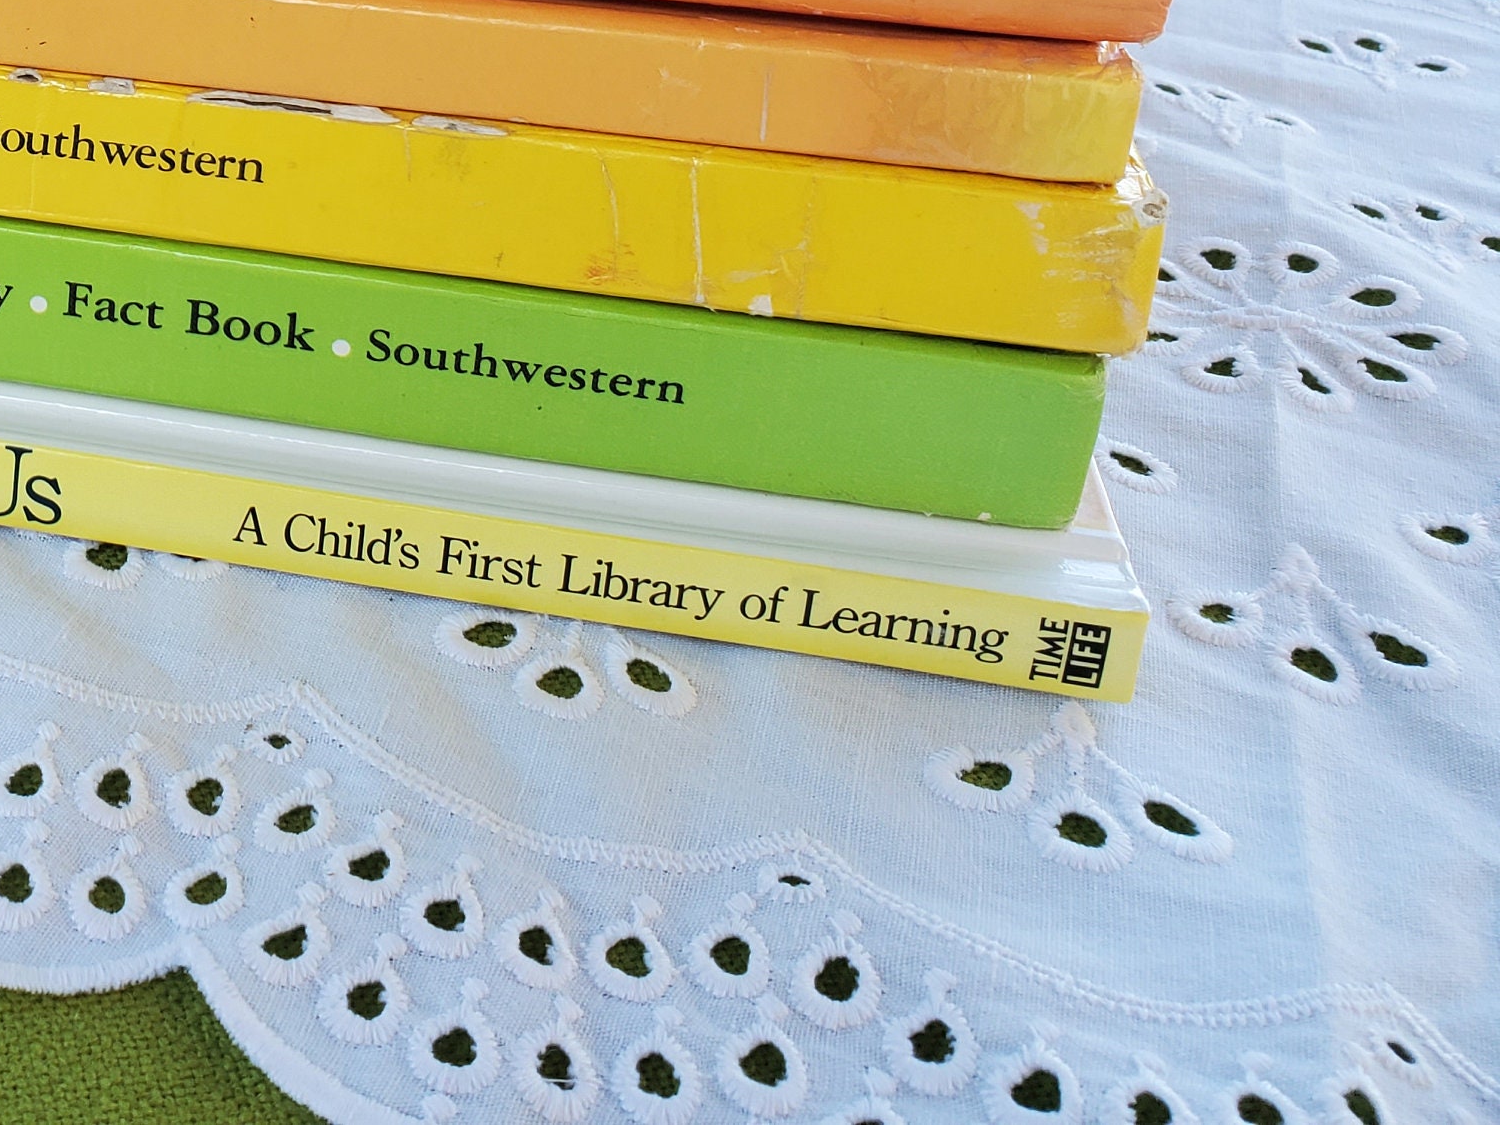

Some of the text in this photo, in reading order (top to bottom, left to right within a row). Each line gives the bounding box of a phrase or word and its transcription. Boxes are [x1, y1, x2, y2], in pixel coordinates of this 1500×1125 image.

[63, 281, 164, 329] Fact
[184, 298, 314, 352] Book
[366, 329, 685, 405] Southwestern
[232, 507, 267, 546] A
[436, 536, 541, 588] First
[557, 554, 725, 621] Library
[740, 586, 789, 623] of
[798, 589, 1009, 663] Learning
[1028, 617, 1070, 681] TIME
[1065, 625, 1108, 686] LIFE
